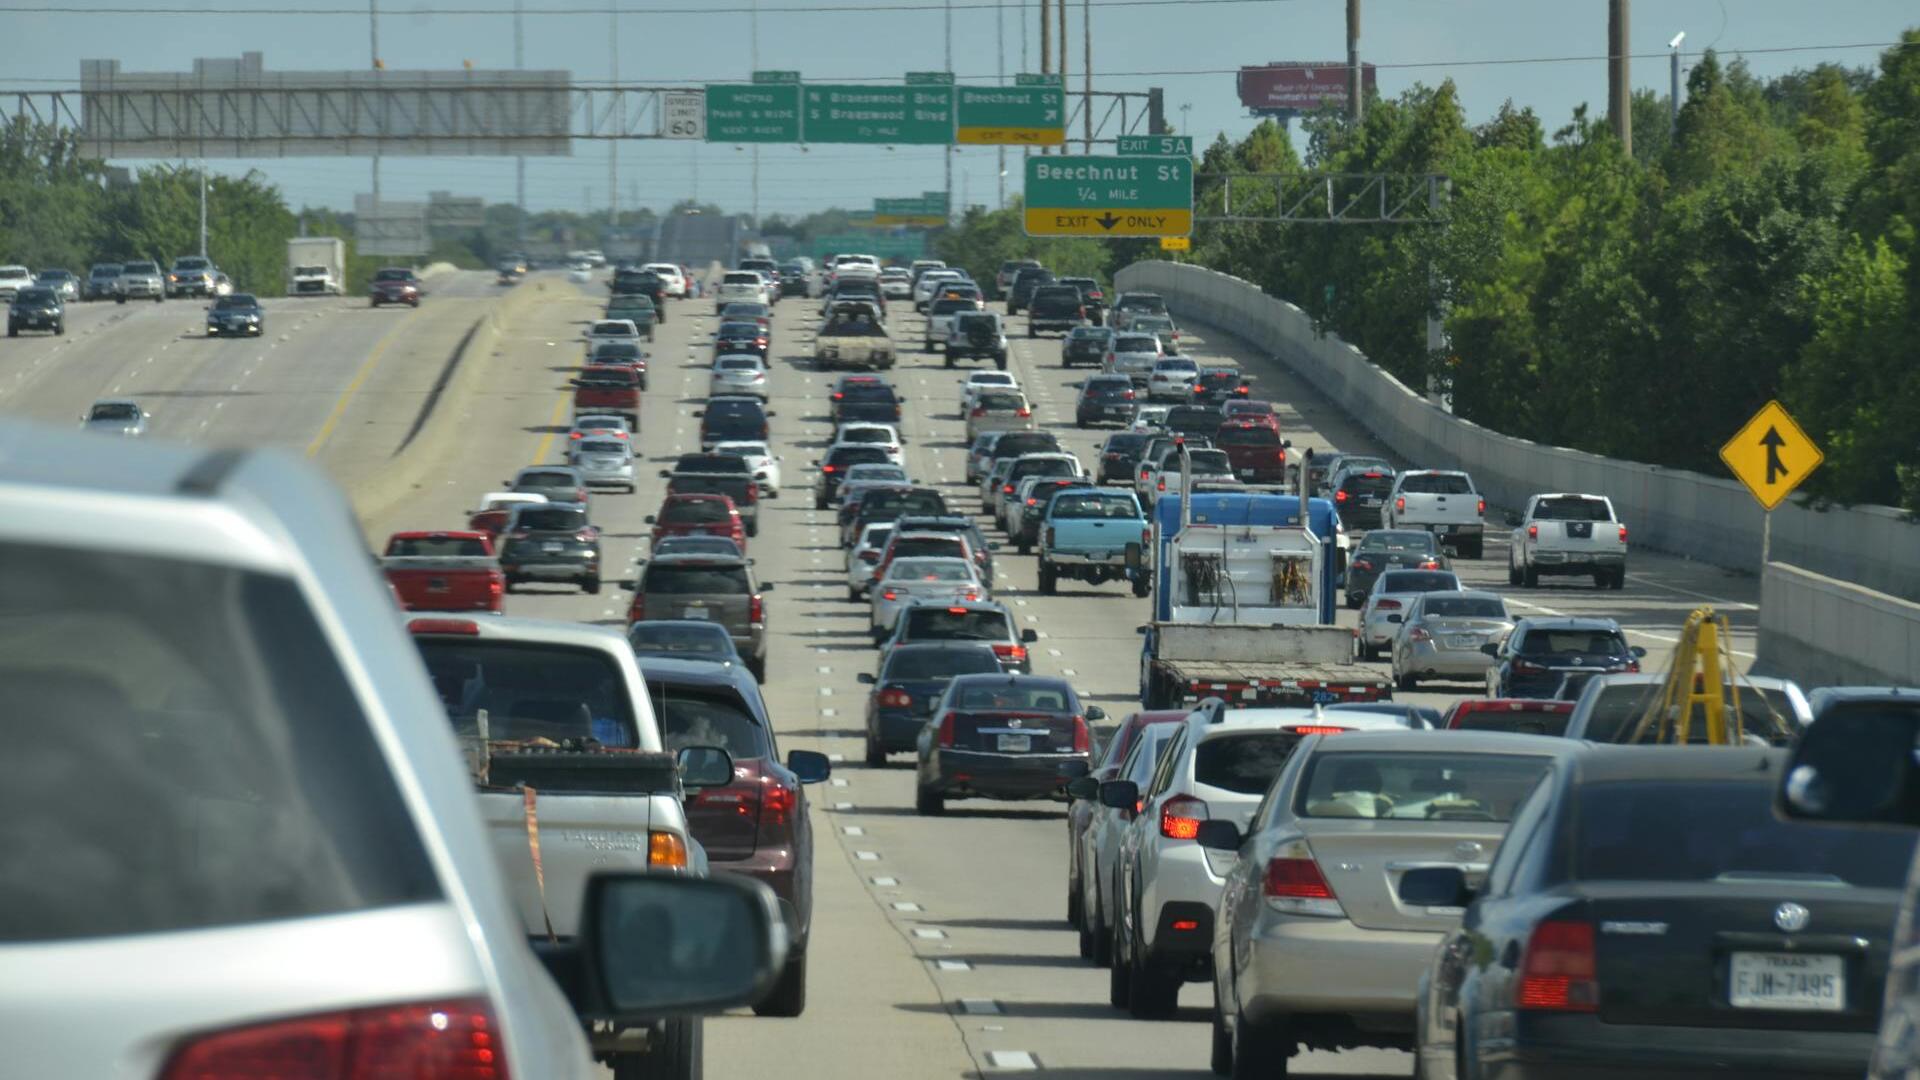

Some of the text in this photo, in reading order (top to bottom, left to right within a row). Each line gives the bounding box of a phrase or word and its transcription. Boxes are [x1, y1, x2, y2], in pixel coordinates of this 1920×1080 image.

[809, 92, 820, 102] N
[914, 92, 948, 104] Blvd
[963, 92, 1057, 104] Beechnut St
[810, 109, 820, 119] S
[914, 109, 947, 121] Blvd
[672, 120, 697, 135] 60
[1121, 138, 1188, 153] EXIT 5A
[1037, 163, 1180, 181] Beechnut St
[1108, 189, 1139, 201] MILE
[1056, 216, 1167, 228] EXIT ONLY
[1764, 956, 1808, 968] TEXAS
